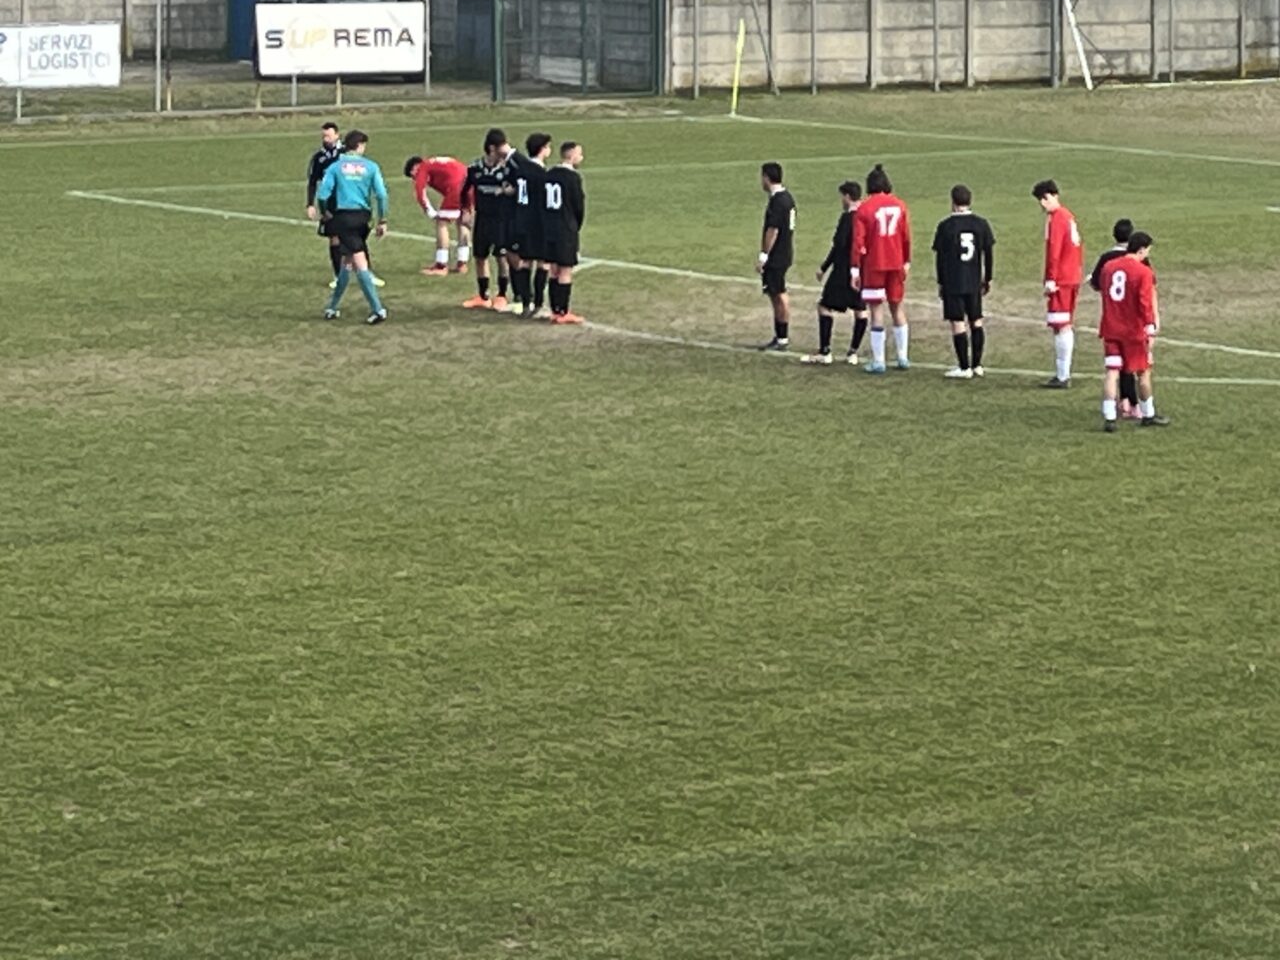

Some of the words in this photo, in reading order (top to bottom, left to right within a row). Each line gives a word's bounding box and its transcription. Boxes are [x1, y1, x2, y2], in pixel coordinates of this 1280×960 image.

[28, 34, 92, 51] SERVIZI
[264, 25, 415, 50] SUPREMA
[545, 182, 562, 210] 10
[874, 206, 901, 237] 17
[960, 232, 975, 262] 5
[1109, 270, 1127, 302] 8
